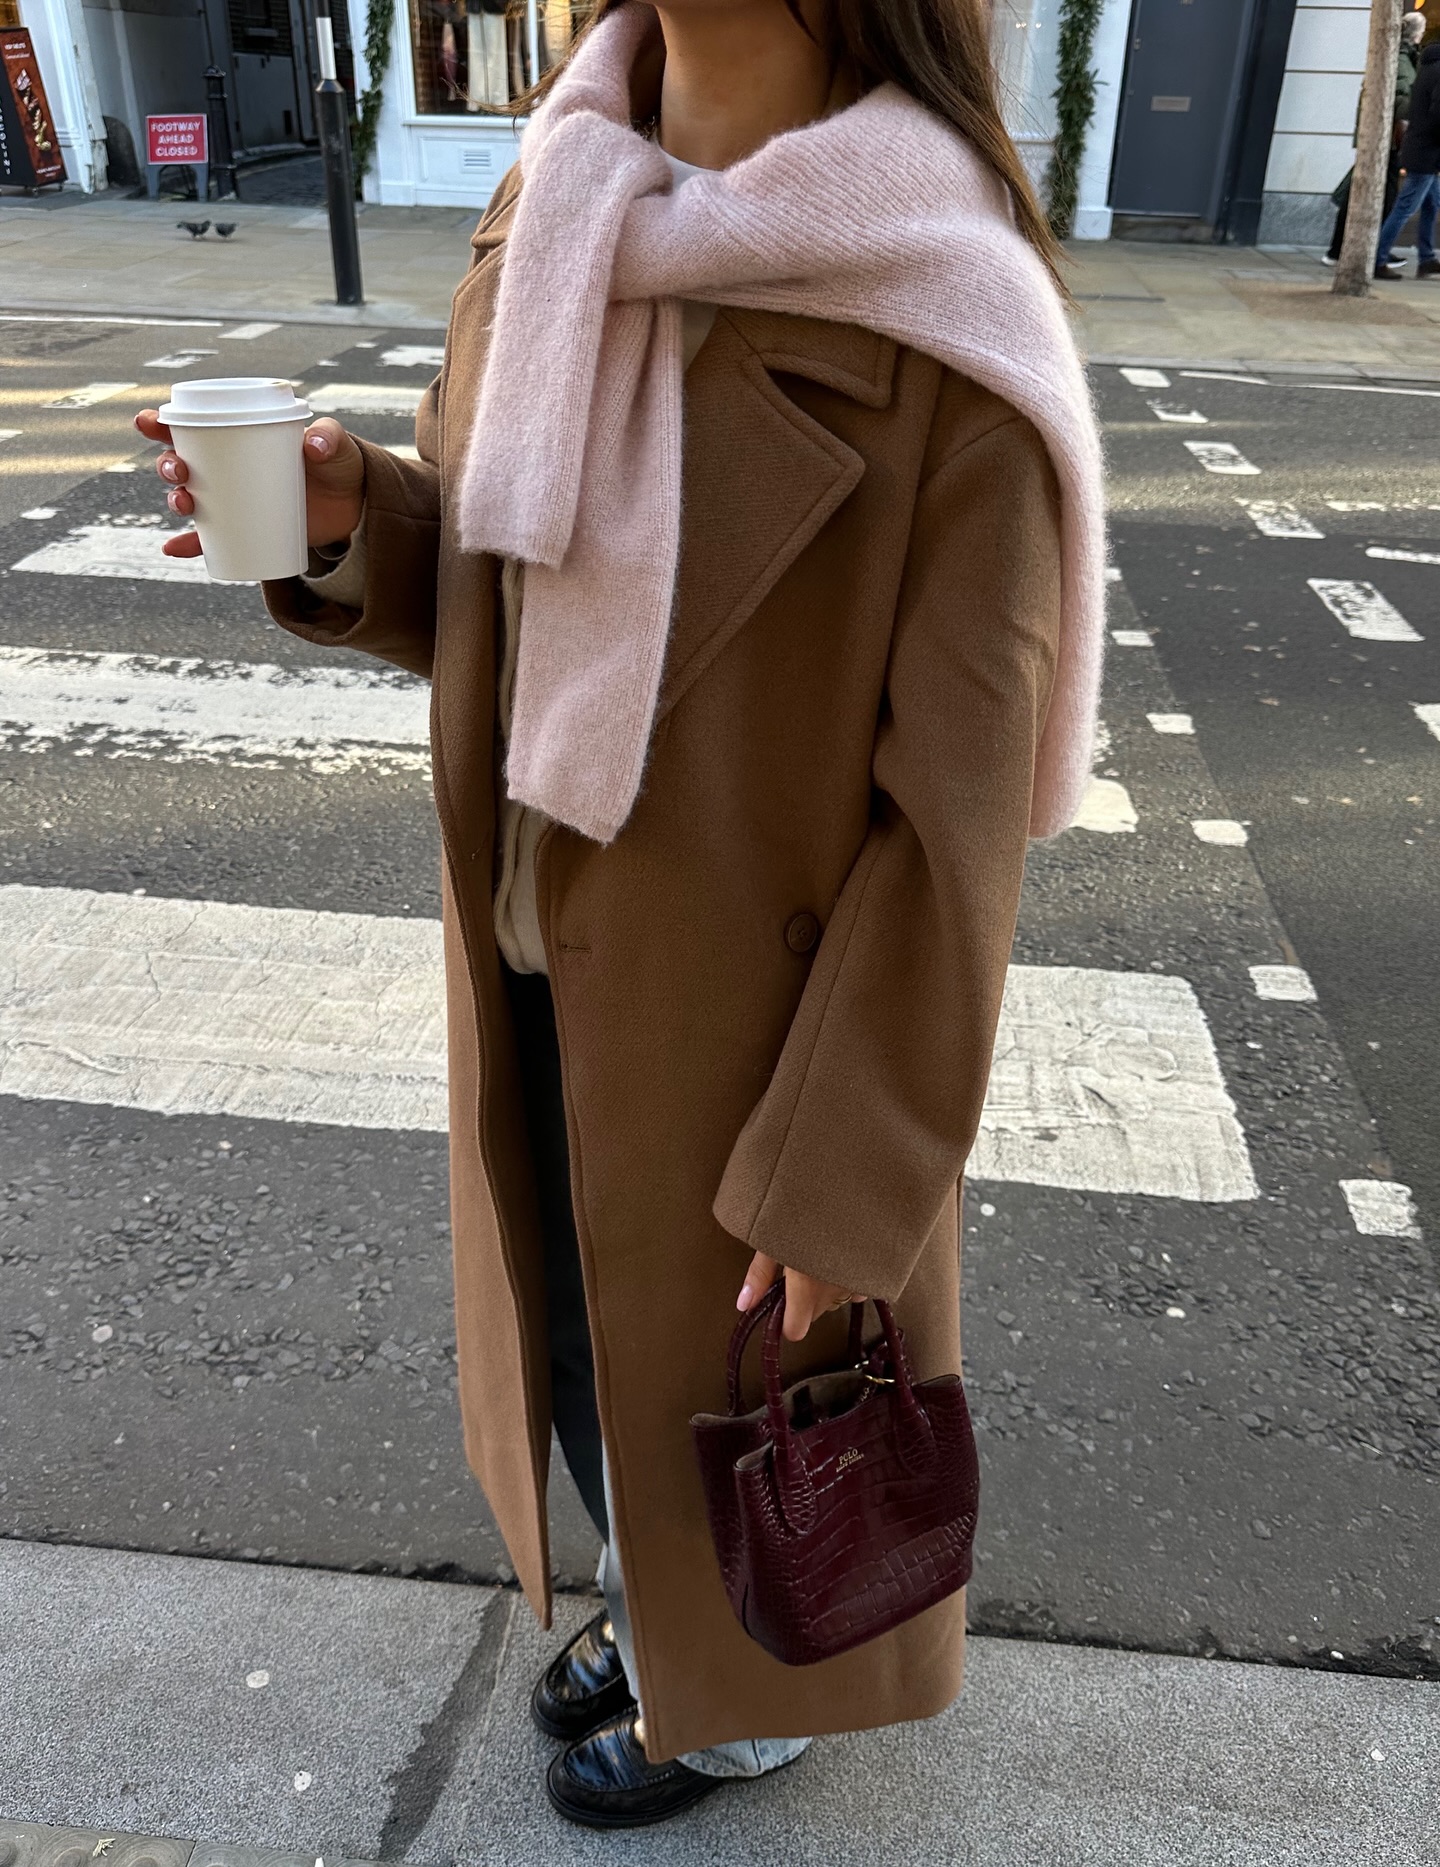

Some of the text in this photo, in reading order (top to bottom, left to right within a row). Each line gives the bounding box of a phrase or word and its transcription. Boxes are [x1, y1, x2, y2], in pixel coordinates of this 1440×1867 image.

[151, 121, 201, 132] FOOTWAY
[158, 133, 195, 144] AHEAD
[155, 145, 198, 157] CLOSED
[838, 1448, 858, 1465] POLO
